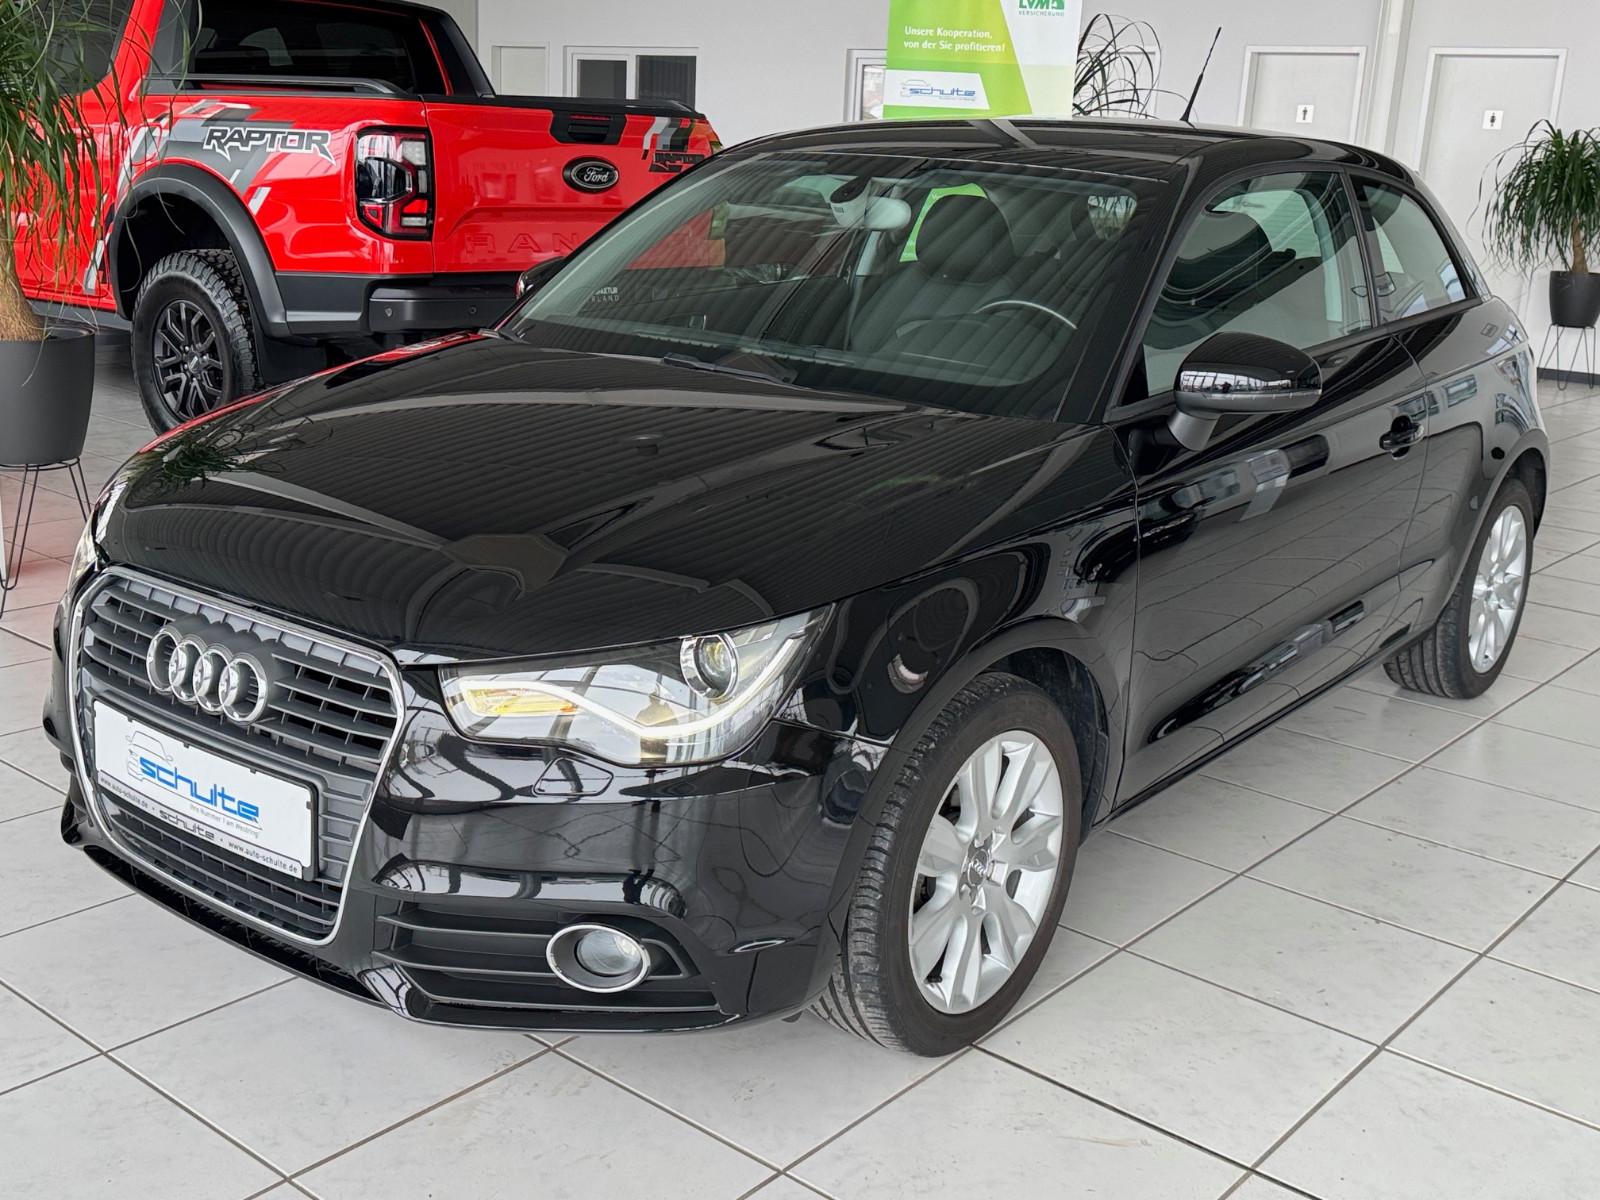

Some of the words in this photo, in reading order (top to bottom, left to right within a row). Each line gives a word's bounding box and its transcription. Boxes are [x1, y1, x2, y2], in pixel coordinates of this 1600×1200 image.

[904, 26, 935, 36] Unsere
[936, 27, 993, 39] Kooperation,
[903, 41, 919, 49] von
[921, 40, 938, 49] der
[938, 40, 953, 51] Sie
[954, 42, 1005, 53] profitieren!
[202, 126, 337, 166] RAPTOR
[583, 166, 609, 183] Ford
[464, 233, 579, 254] RAN
[139, 756, 259, 824] schulte
[159, 809, 215, 841] schulte
[228, 841, 299, 874] www.auto-schulte.de
